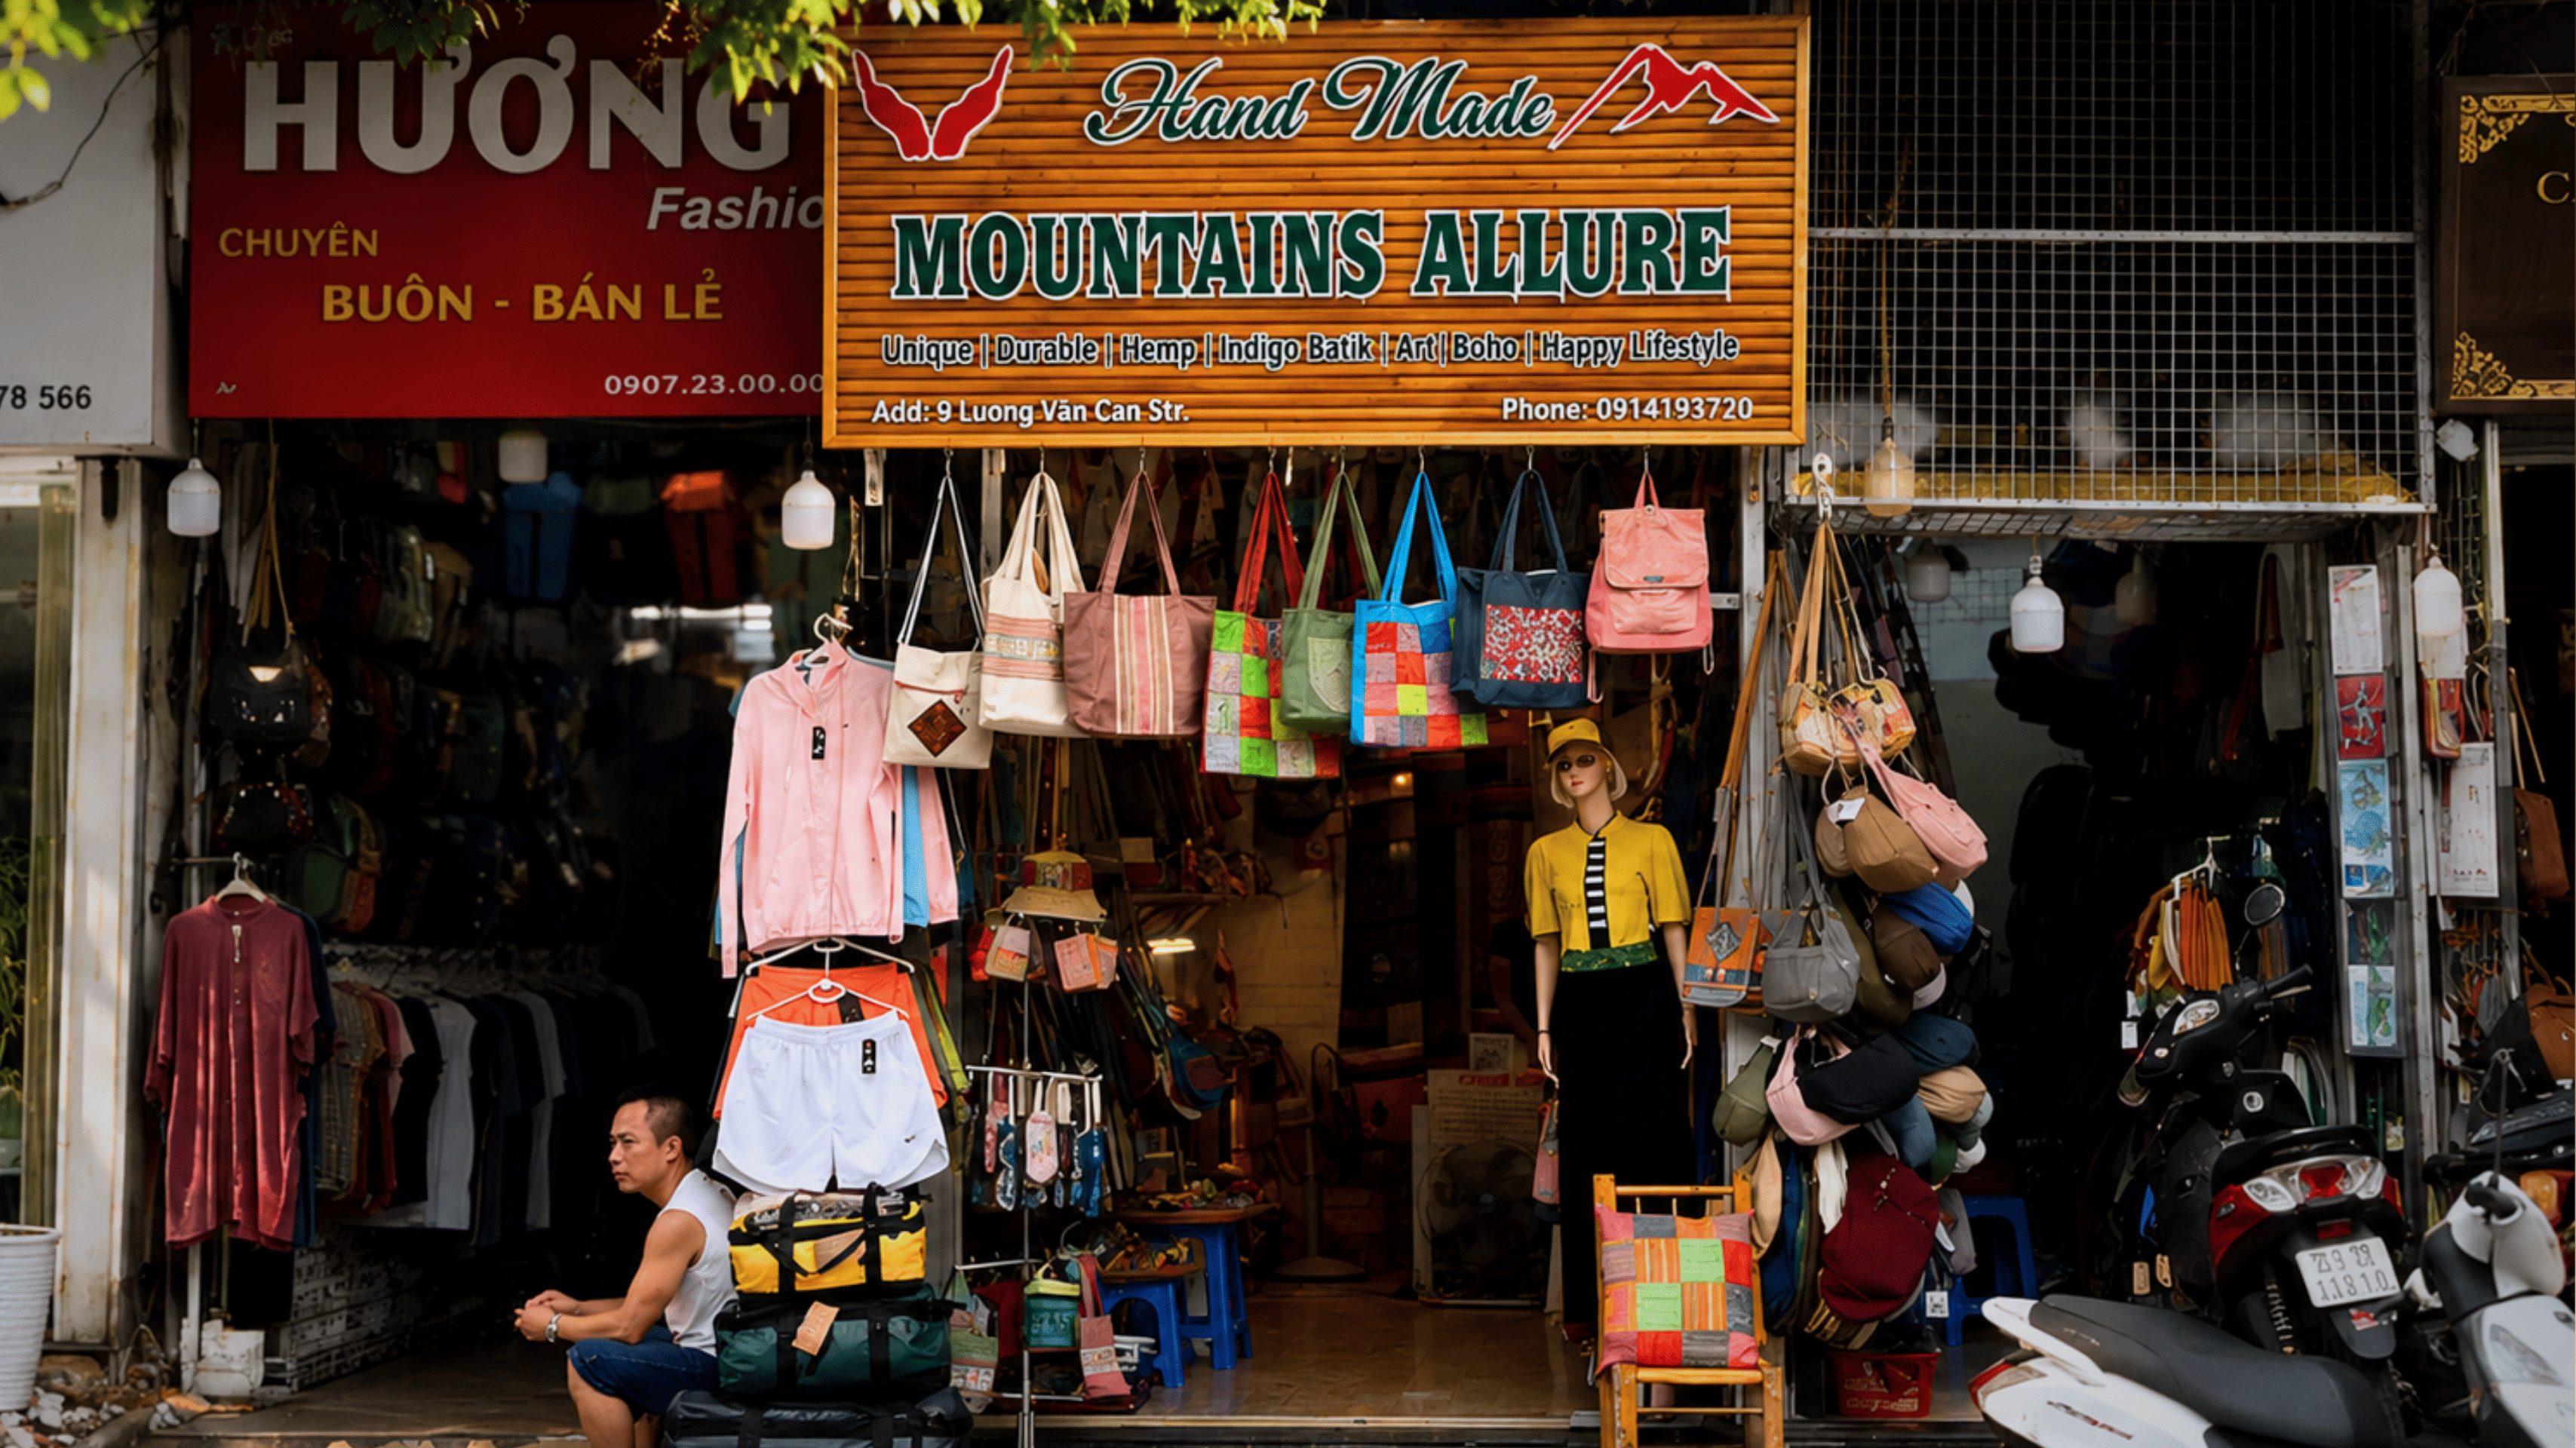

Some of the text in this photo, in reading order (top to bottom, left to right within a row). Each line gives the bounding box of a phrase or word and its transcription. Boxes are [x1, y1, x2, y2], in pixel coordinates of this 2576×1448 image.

[244, 34, 790, 174] HƯƠNG
[1084, 56, 1556, 146] Hand Made
[219, 221, 379, 258] CHUYÊN
[891, 205, 1731, 303] MOUNTAINS ALLURE
[322, 272, 473, 323] BUÔN
[532, 272, 643, 321] BÁN
[664, 268, 723, 321] LẺ
[882, 334, 974, 371] Unique
[995, 333, 1099, 364] Durable
[1120, 333, 1198, 370] Hemp
[1219, 332, 1301, 371] Indigo
[1306, 331, 1375, 363] Batik
[1451, 330, 1519, 361] Boho
[1540, 330, 1626, 368] Happy
[1629, 328, 1739, 367] Lifestyle
[38, 385, 92, 410] 566
[871, 398, 930, 423] Add:
[937, 400, 952, 423] 9
[959, 399, 1033, 428] Luong
[1095, 397, 1141, 422] Can
[1148, 397, 1190, 422] Str.
[1503, 396, 1754, 420] Phone: 0914193720
